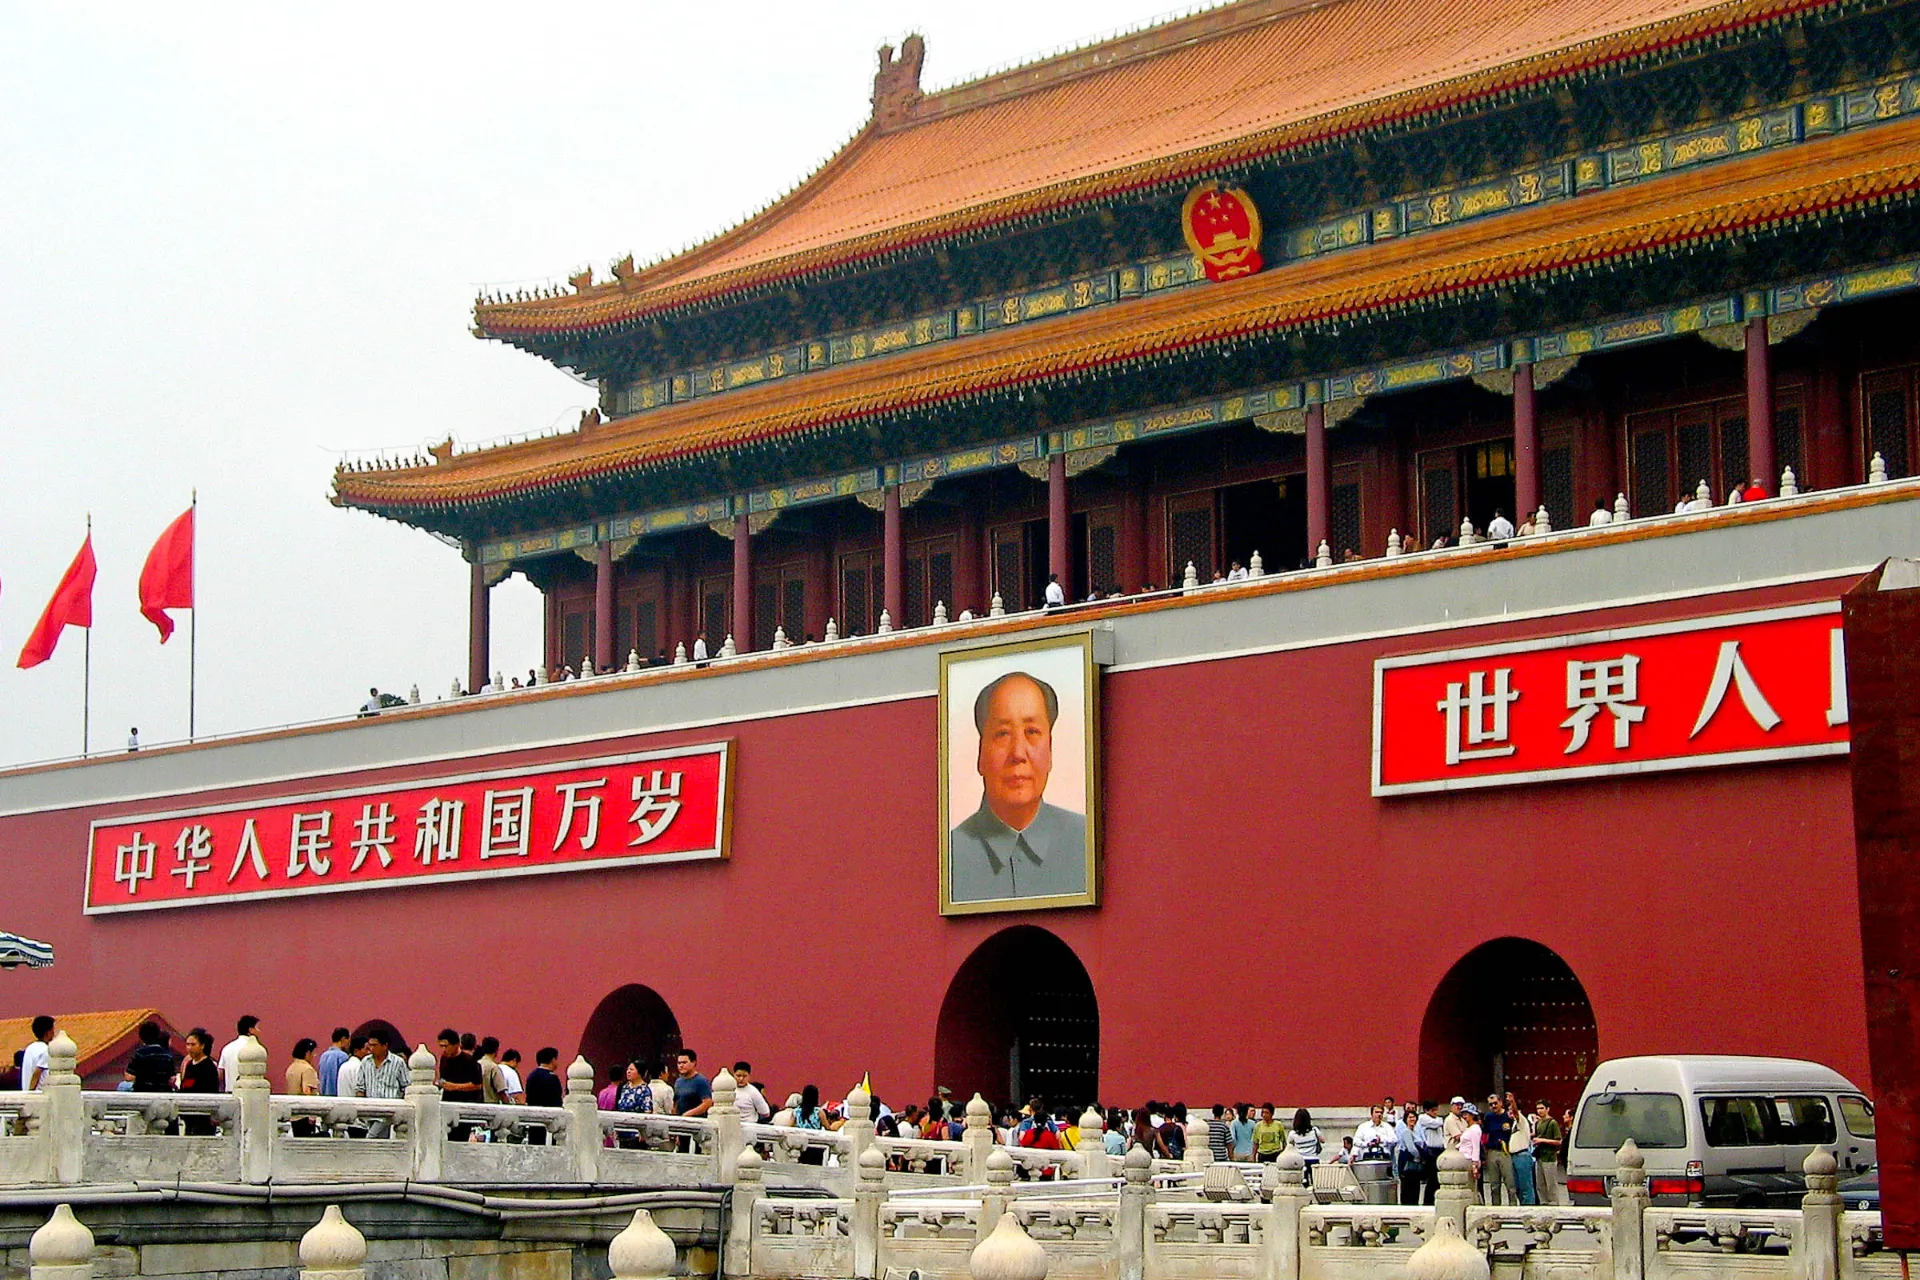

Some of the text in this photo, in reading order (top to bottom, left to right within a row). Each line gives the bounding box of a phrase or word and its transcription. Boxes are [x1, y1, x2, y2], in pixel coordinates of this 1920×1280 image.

[1437, 628, 1850, 765] 世界人
[114, 770, 683, 894] 中华人民共和国万岁
